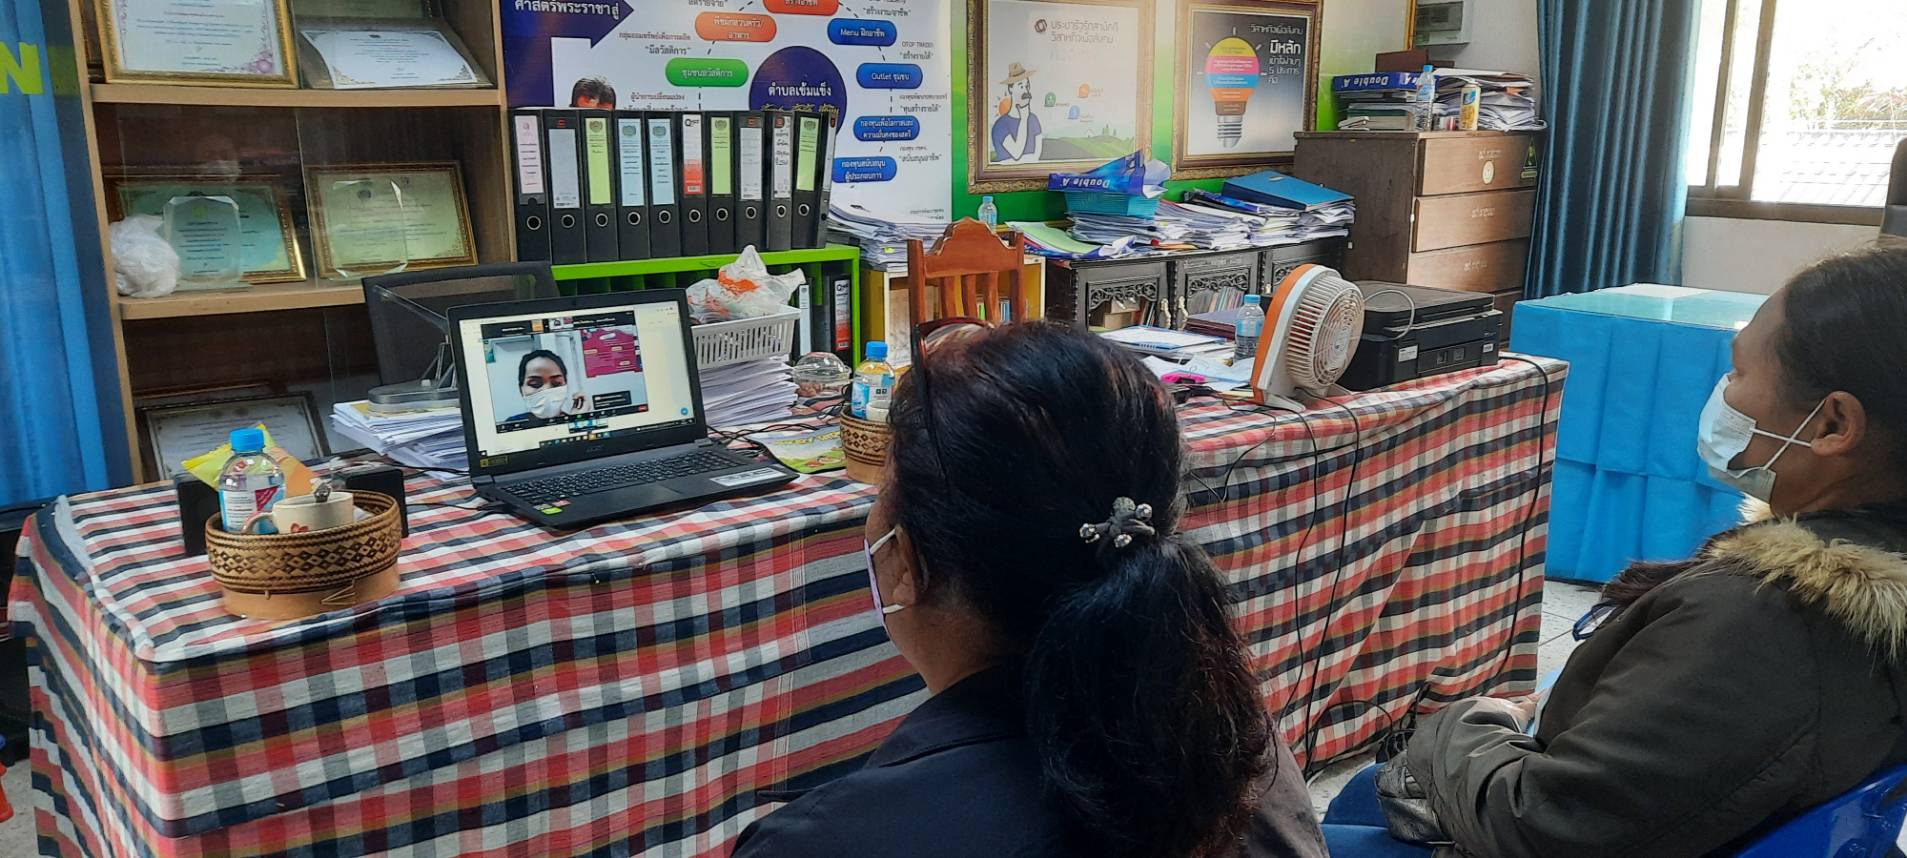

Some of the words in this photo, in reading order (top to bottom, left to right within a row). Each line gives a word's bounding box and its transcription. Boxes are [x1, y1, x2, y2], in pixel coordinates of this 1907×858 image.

[840, 29, 860, 37] Menu
[1269, 40, 1301, 55] มีหลัก
[871, 72, 892, 80] Outlet
[1353, 75, 1389, 86] Double
[768, 81, 832, 97] ตำบลเข้มแข็ง
[1073, 178, 1111, 189] Double
